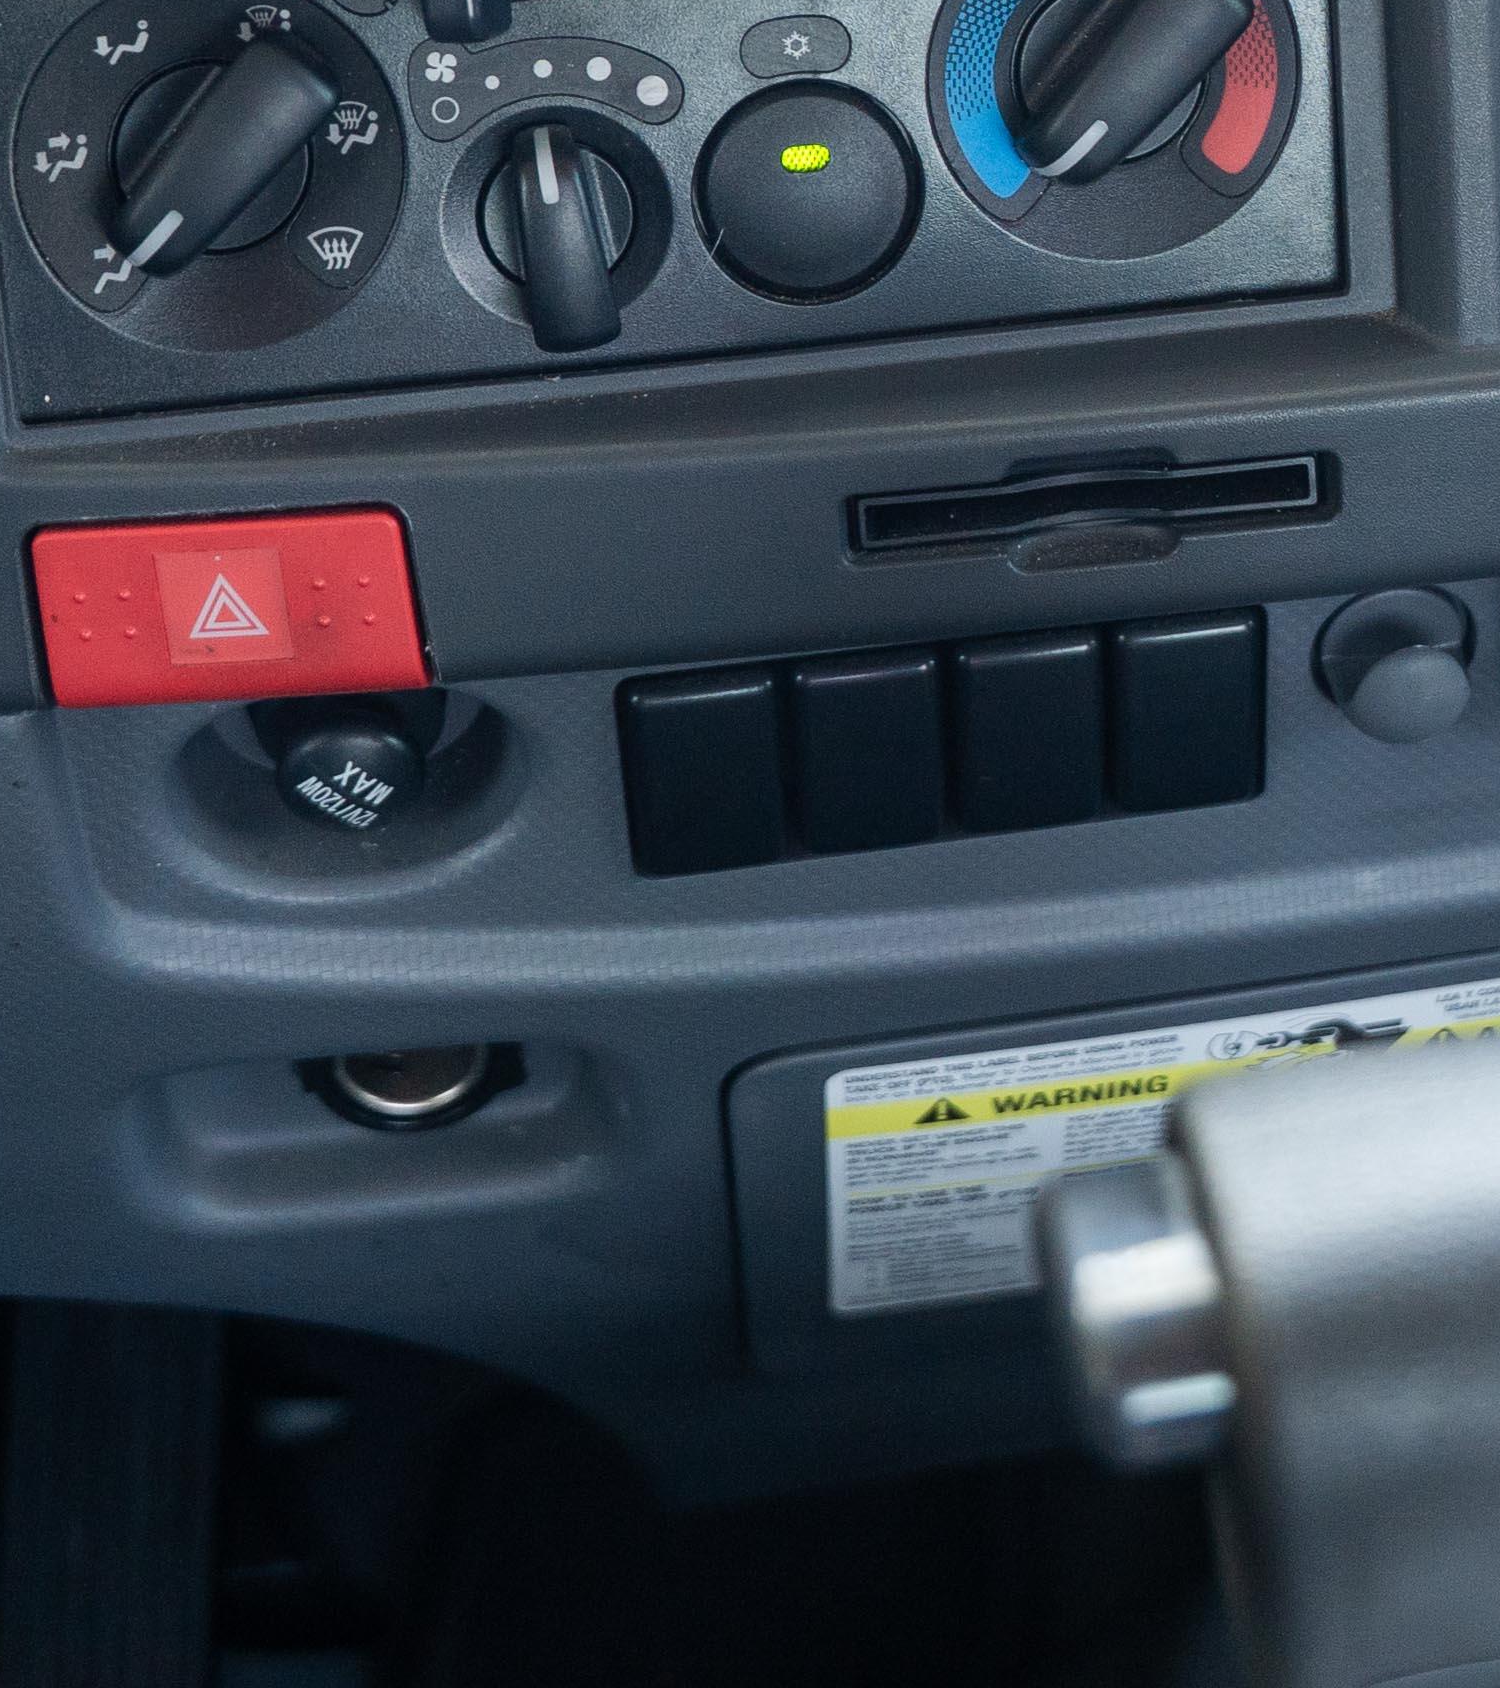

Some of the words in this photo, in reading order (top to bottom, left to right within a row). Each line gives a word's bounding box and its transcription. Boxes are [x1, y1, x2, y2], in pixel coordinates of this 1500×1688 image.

[296, 776, 379, 827] 12V/120W
[332, 760, 395, 806] MAX
[992, 1075, 1168, 1112] WARNING
